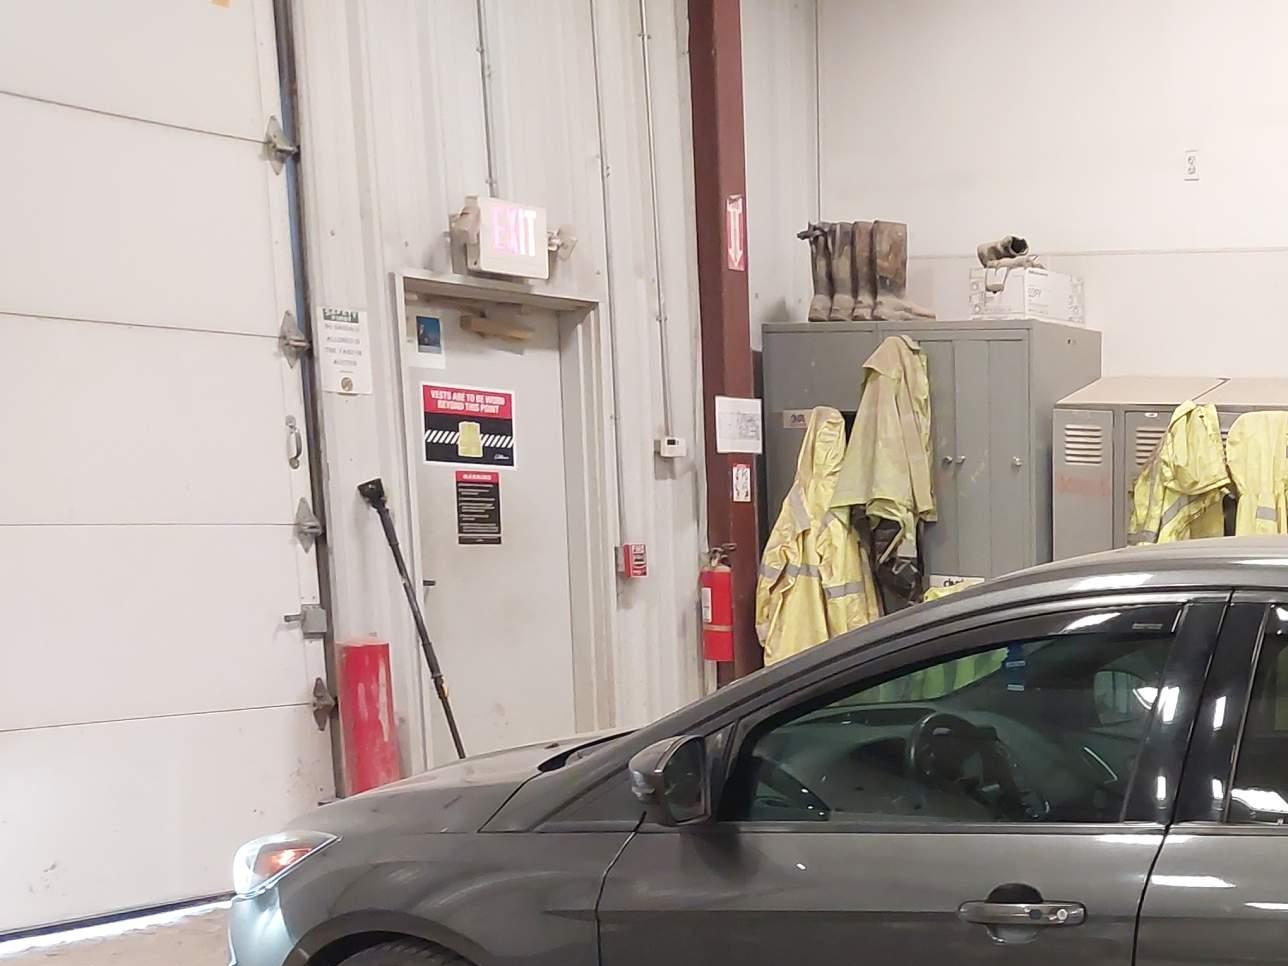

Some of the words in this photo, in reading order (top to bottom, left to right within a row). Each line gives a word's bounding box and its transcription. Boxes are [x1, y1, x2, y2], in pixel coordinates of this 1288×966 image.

[491, 208, 537, 256] EXIT
[430, 389, 452, 400] VESTS
[452, 391, 465, 402] ARE
[466, 393, 475, 402] TO
[475, 394, 485, 403] BE
[485, 395, 506, 405] WORN
[437, 399, 465, 410] BEYOND
[465, 402, 480, 412] THIS
[480, 403, 500, 414] POINT
